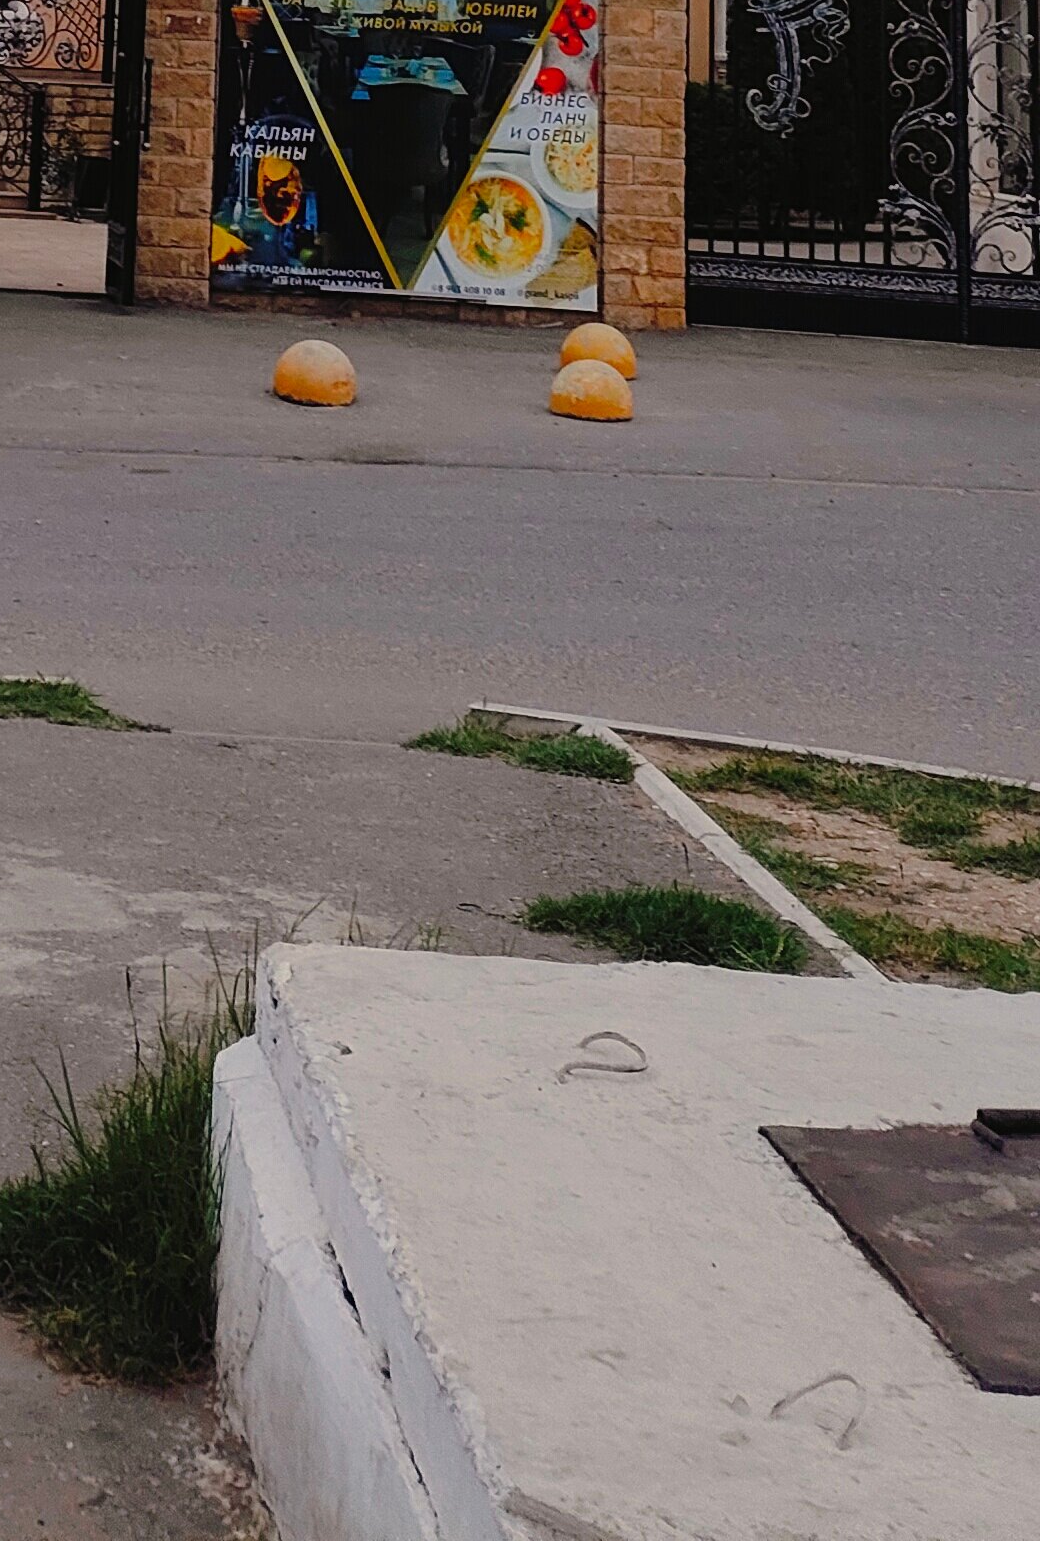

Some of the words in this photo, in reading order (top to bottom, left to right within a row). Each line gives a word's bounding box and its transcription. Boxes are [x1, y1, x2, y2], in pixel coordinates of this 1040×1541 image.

[465, 2, 538, 19] ЮБИЛЕИ
[352, 16, 406, 30] ЖИВОЙ
[409, 18, 483, 34] МУЗЫКОЙ
[520, 92, 588, 109] БИЗНЕС
[540, 111, 587, 126] ЛАНЧ
[244, 124, 316, 142] КАЛЬЯН
[510, 127, 522, 139] И
[527, 127, 586, 145] ОБЕДЫ
[229, 142, 308, 161] КАБИНЫ
